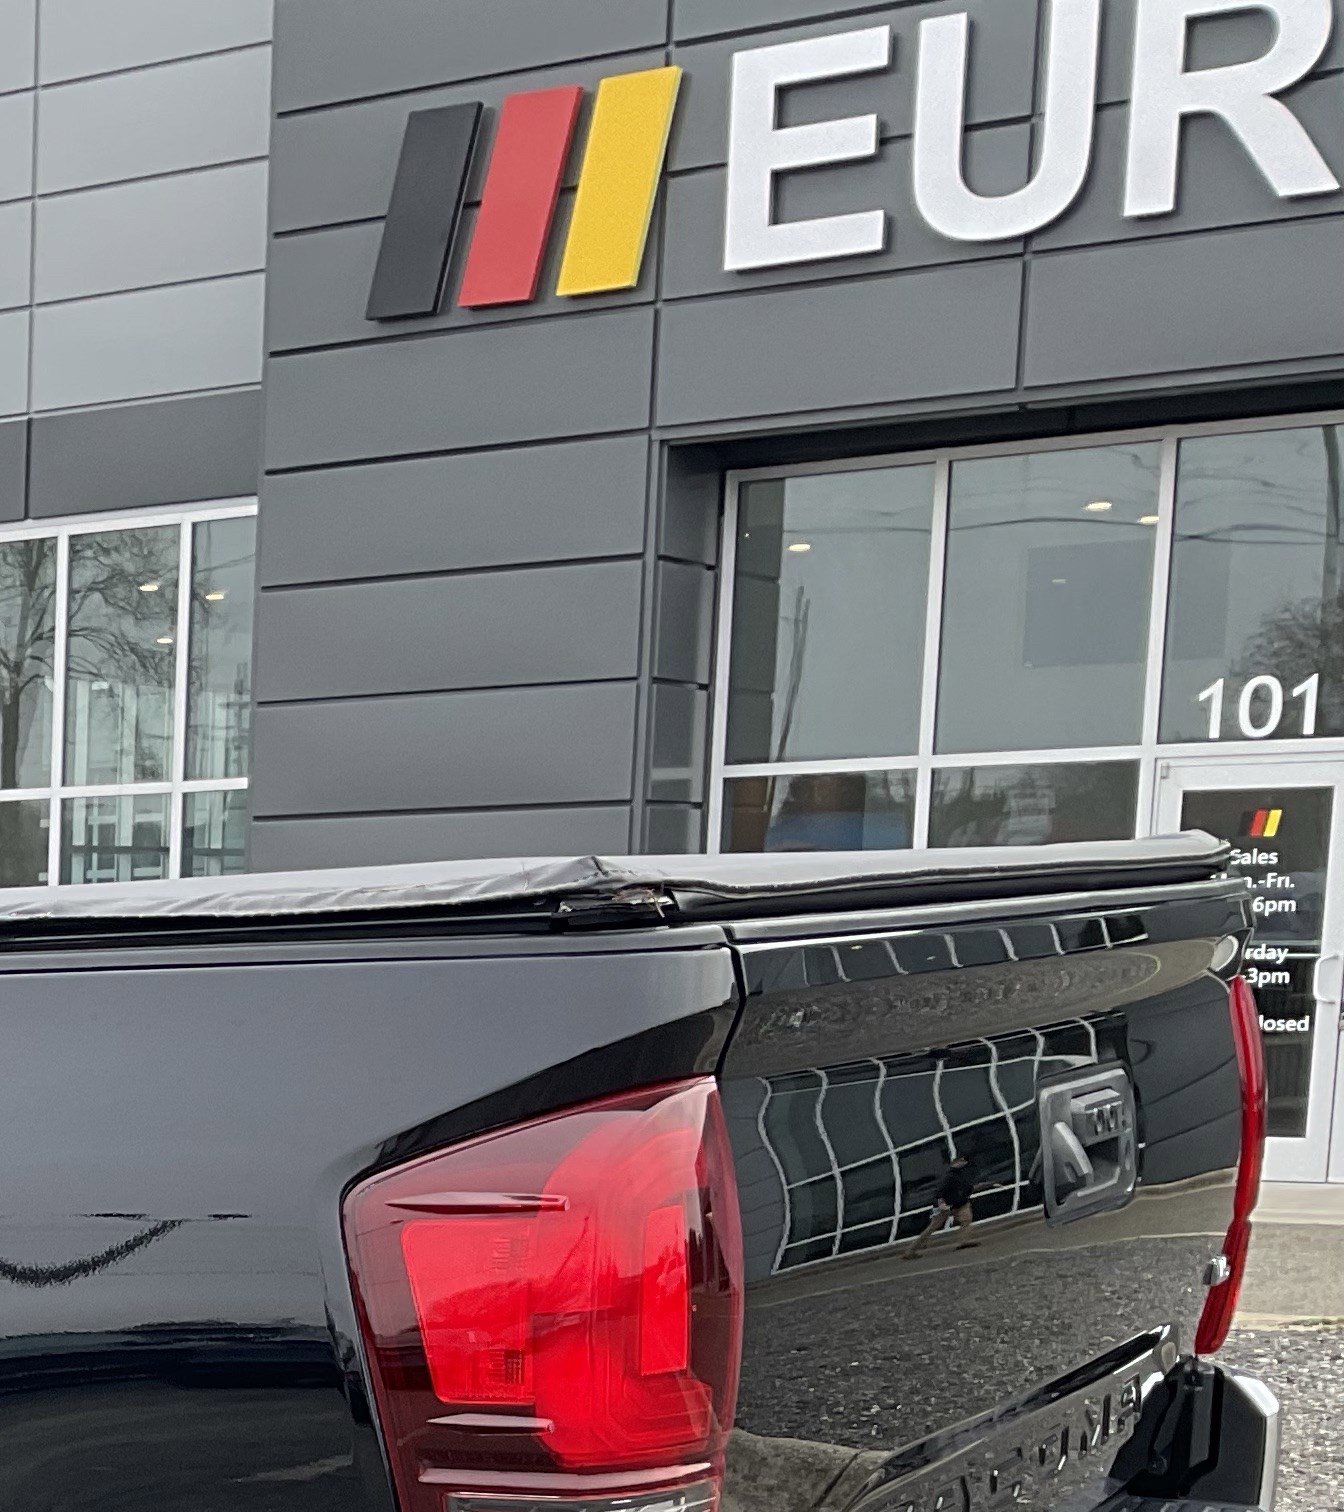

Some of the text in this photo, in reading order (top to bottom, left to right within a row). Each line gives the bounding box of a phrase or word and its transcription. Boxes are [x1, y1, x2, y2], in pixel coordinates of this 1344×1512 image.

[723, 0, 1340, 272] EUR
[1197, 672, 1320, 739] 101
[1229, 848, 1279, 866] Sales
[1210, 872, 1296, 889] n.-Fri.
[1252, 896, 1297, 917] 6pm
[1244, 943, 1289, 964] rday
[1240, 967, 1291, 989] -3pm
[1259, 1014, 1311, 1032] losed
